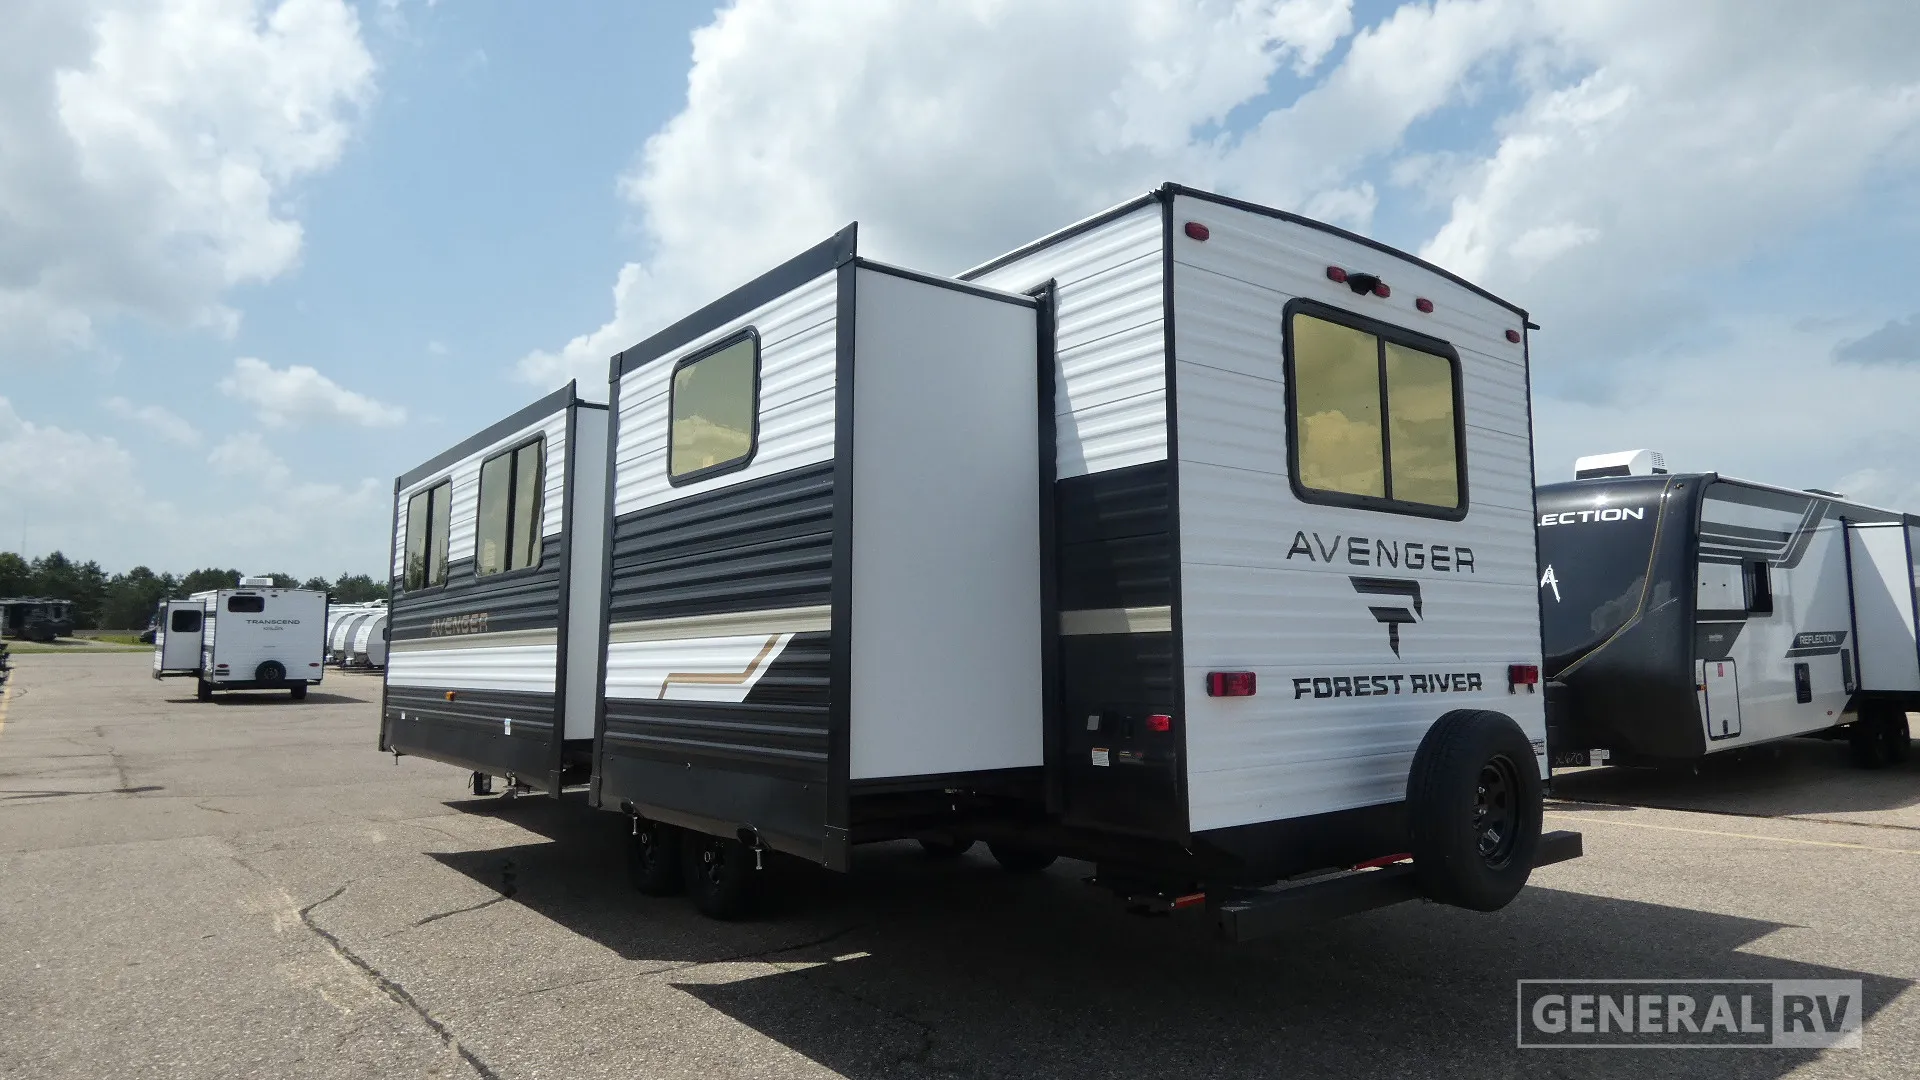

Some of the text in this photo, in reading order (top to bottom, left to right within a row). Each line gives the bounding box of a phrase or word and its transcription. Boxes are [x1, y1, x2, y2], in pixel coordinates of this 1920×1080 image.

[1537, 507, 1644, 527] ECTION
[1286, 530, 1475, 574] AVENGER
[430, 612, 488, 637] AVENGER
[1800, 634, 1837, 645] REFLECTION
[1292, 672, 1483, 700] FOREST RIVER
